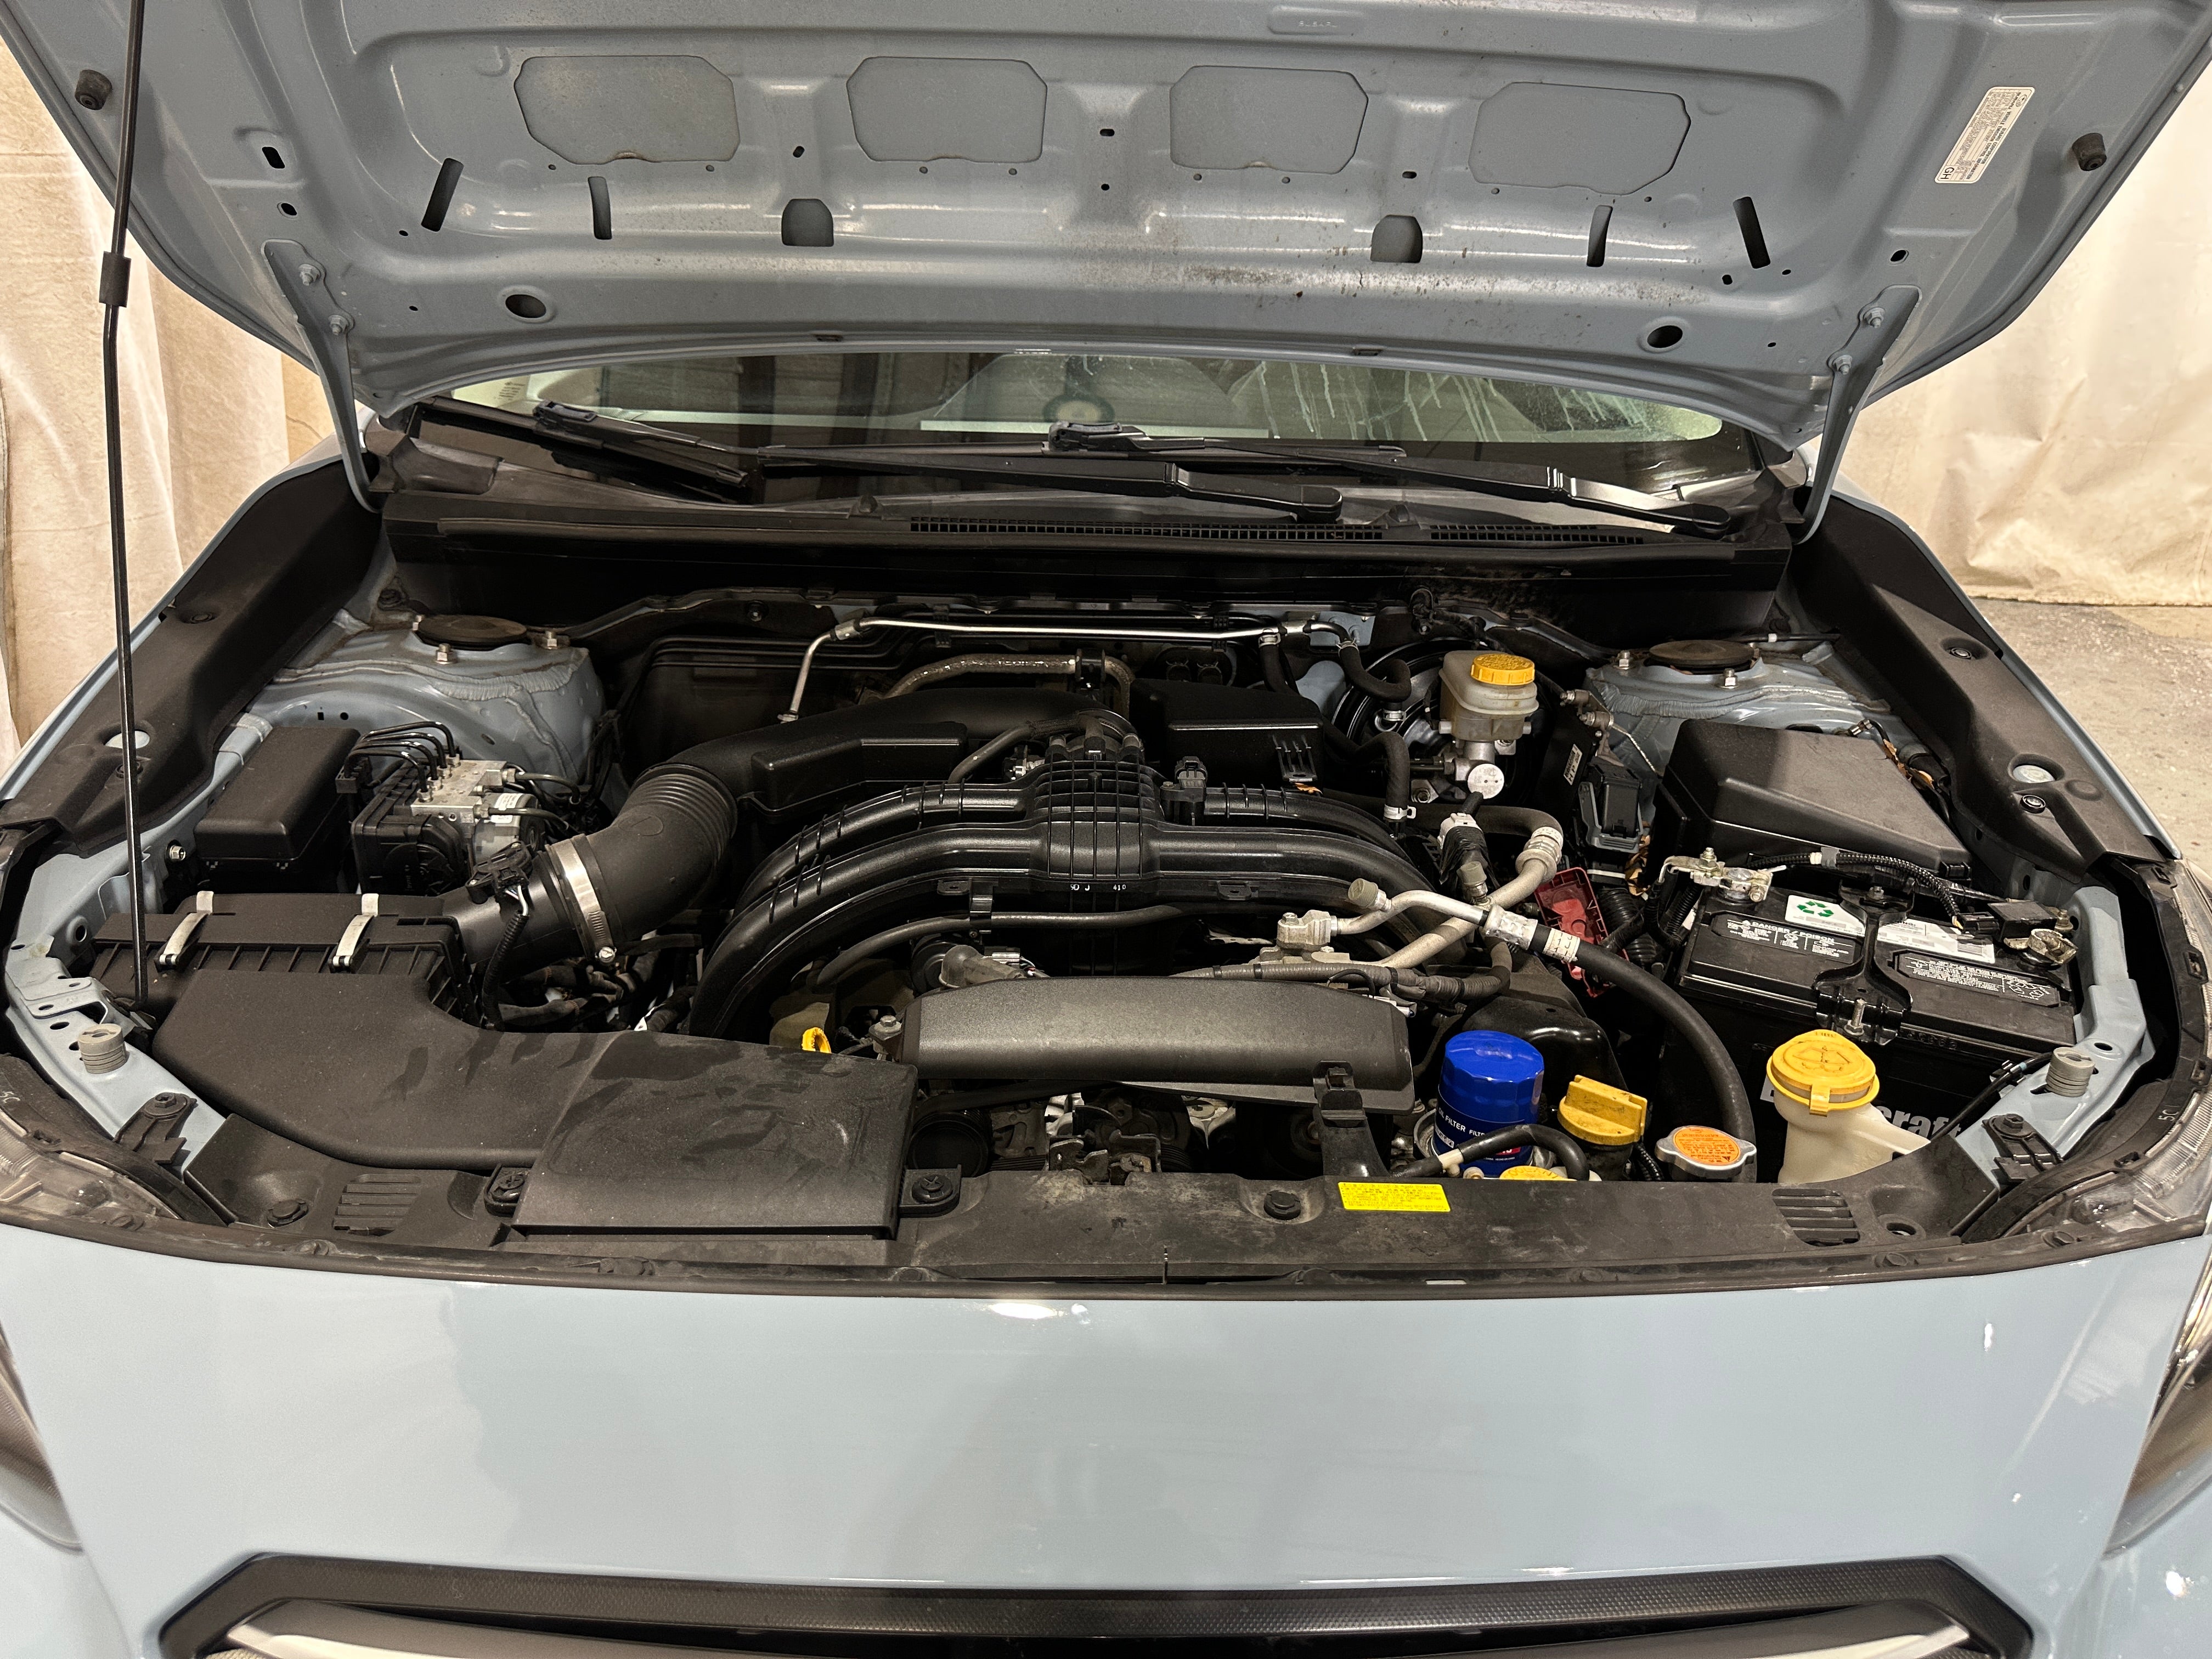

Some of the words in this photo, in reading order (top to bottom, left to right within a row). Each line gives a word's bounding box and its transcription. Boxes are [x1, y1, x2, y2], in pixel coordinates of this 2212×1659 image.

[1940, 167, 1955, 179] GH
[1752, 921, 1791, 934] DANGER
[1800, 932, 1835, 943] POISON
[1445, 1115, 1466, 1132] FILTER
